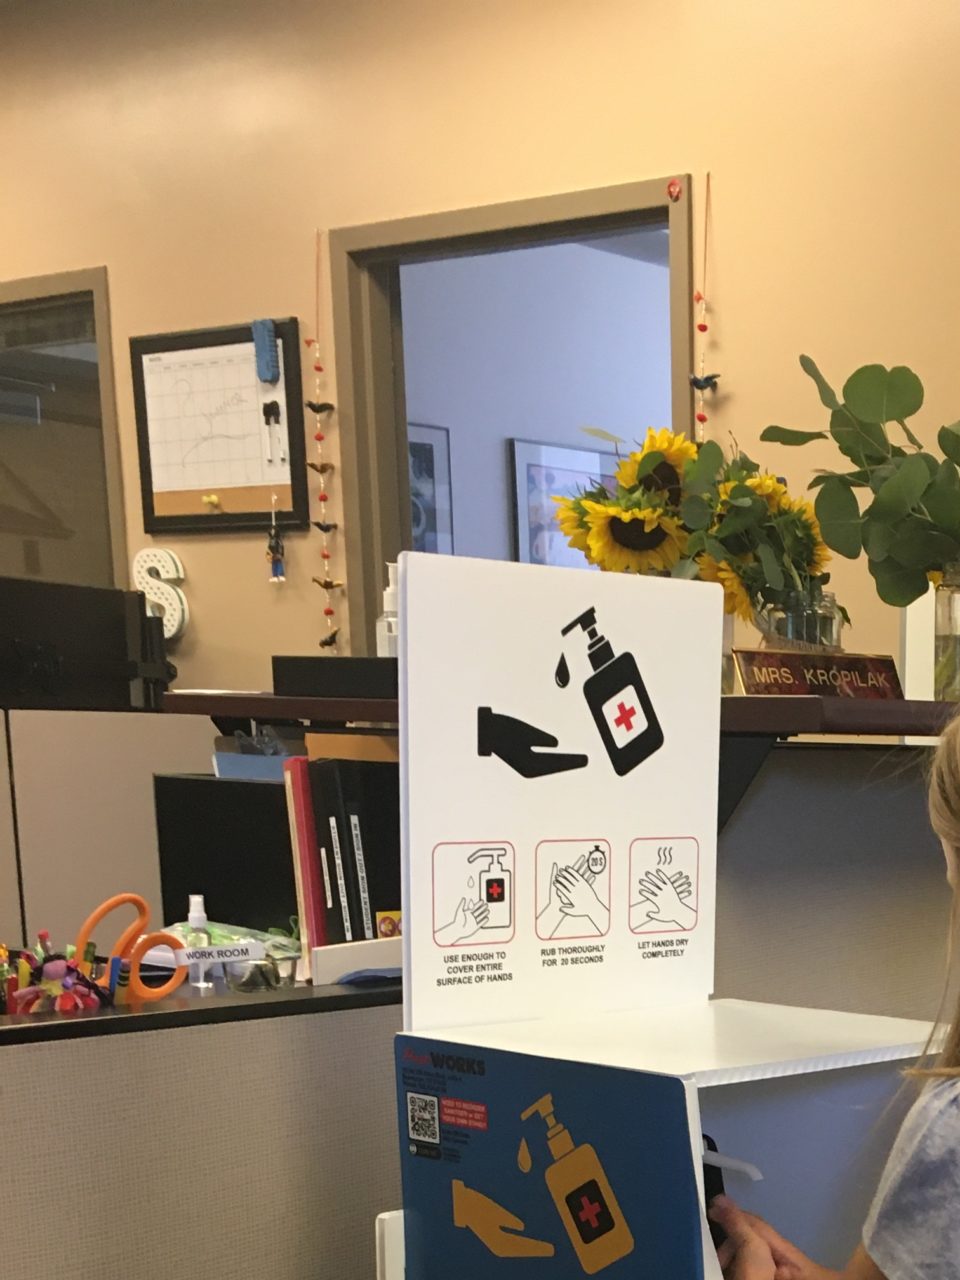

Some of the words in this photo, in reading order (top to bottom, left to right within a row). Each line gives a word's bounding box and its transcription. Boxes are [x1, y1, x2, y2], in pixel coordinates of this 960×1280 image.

[753, 666, 799, 684] MRS.
[804, 668, 890, 688] KROPILAK
[637, 941, 651, 949] LET
[651, 939, 674, 948] HANDS
[675, 938, 689, 946] DRY
[186, 950, 215, 960] WORK
[217, 948, 250, 959] ROOM
[540, 948, 556, 956] RUB
[558, 944, 605, 955] THOROUGHLY
[642, 949, 684, 960] COMPLETELY
[443, 954, 460, 964] USE
[461, 952, 494, 962] ENOUGH
[496, 951, 507, 960] TO
[542, 958, 558, 967] FOR
[560, 957, 569, 966] 20
[570, 955, 604, 965] SECONDS
[446, 965, 474, 975] COVER
[475, 962, 503, 972] ENTIRE
[436, 975, 473, 987] SURFACE
[474, 974, 485, 984] OF
[486, 973, 513, 982] HANDS
